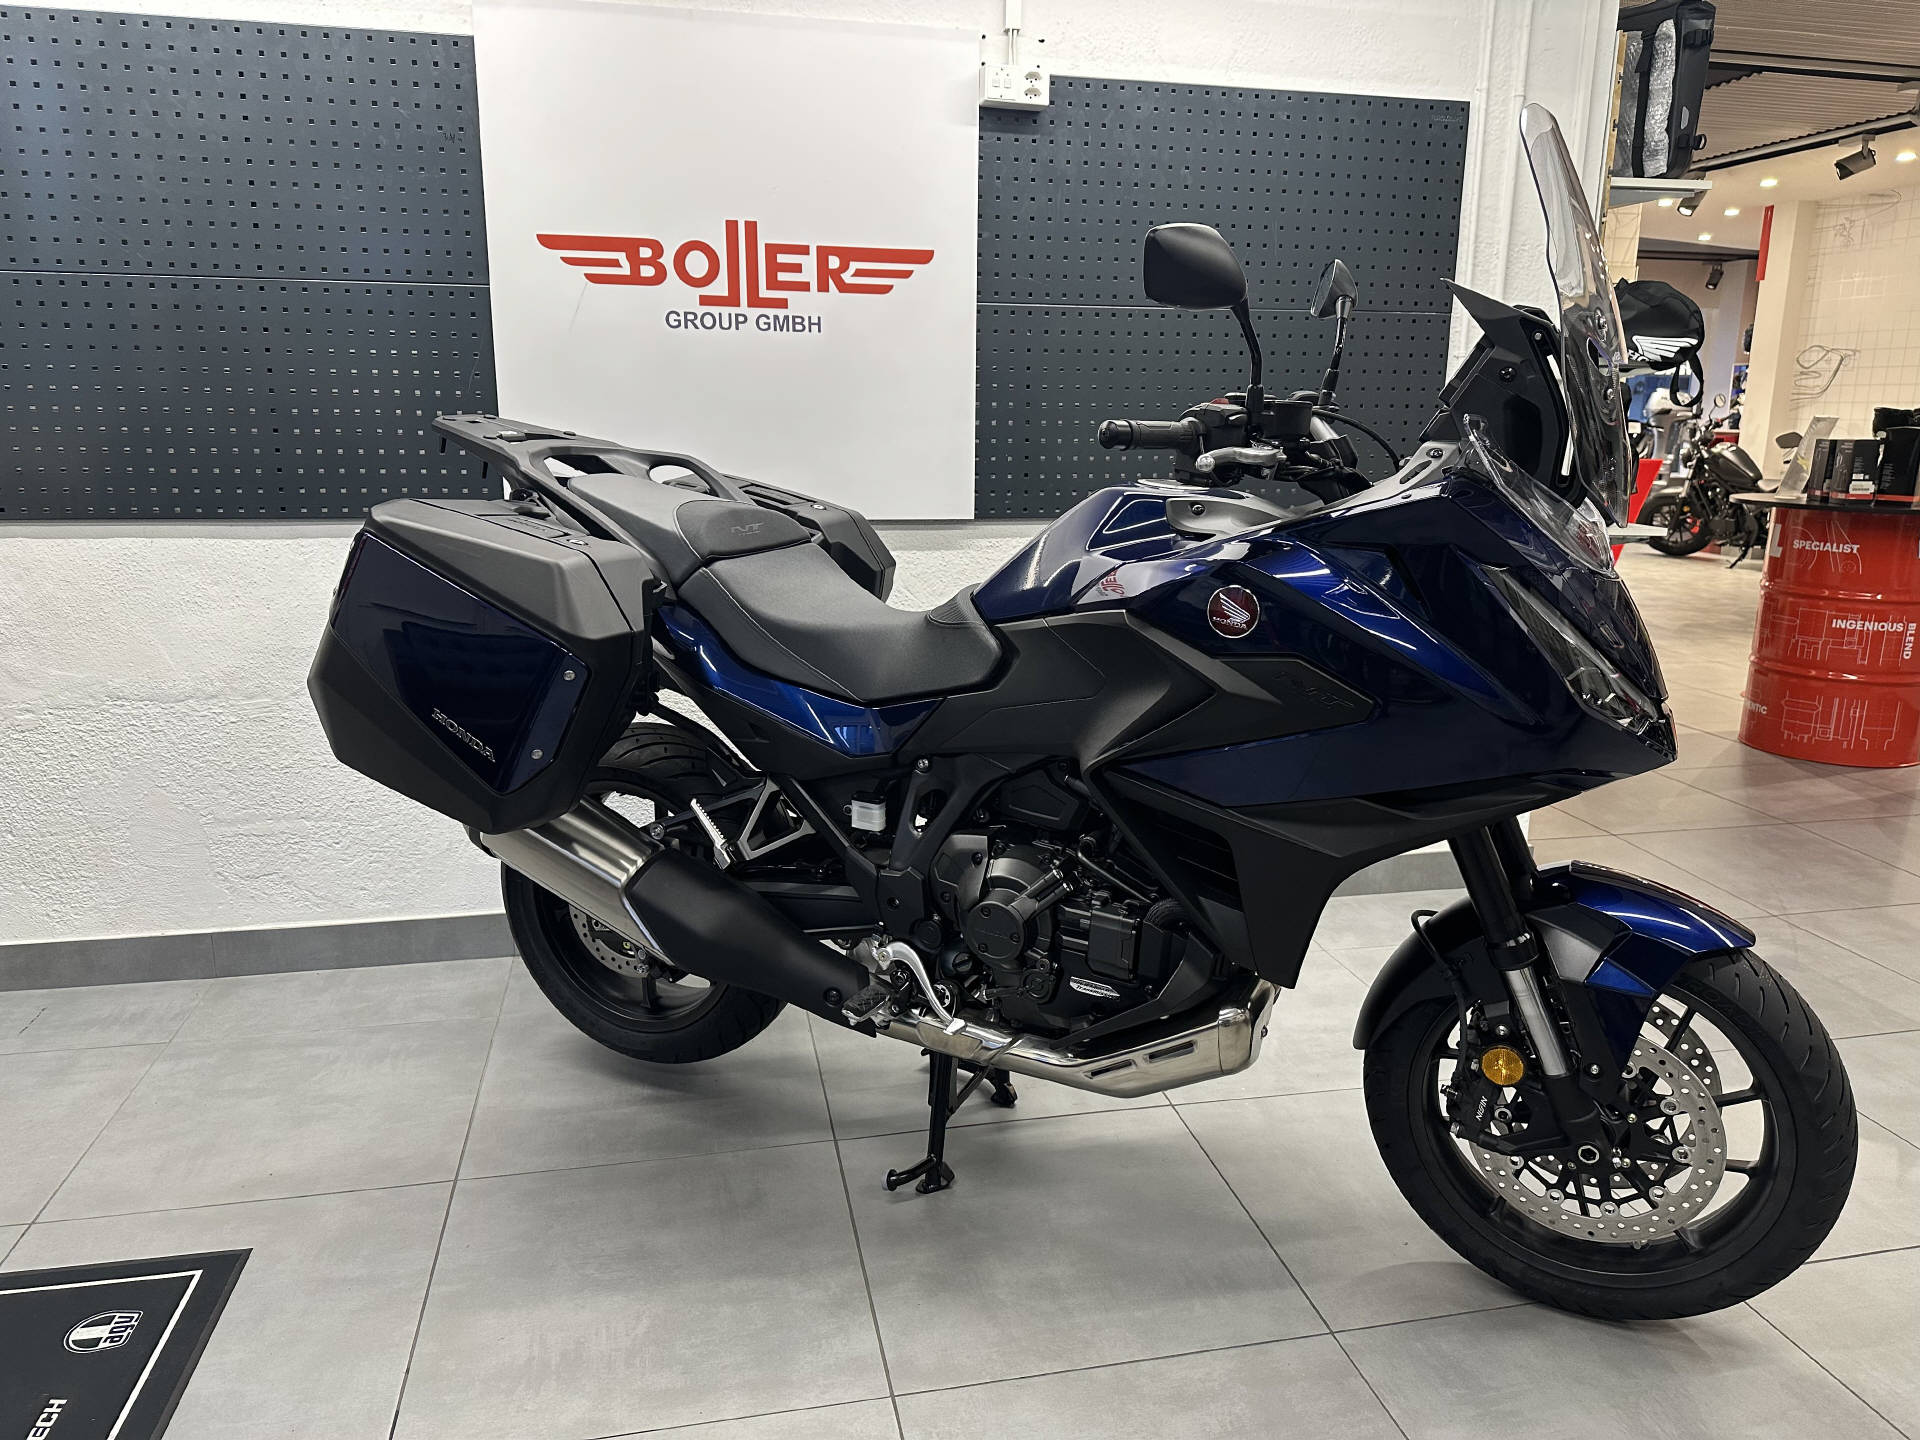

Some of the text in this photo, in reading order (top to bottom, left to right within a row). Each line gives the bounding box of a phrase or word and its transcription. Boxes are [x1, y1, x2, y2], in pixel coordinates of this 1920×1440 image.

[536, 219, 935, 309] BOLLER
[665, 310, 822, 333] GROUP GMBH
[1792, 539, 1860, 554] SPECIALIST
[1832, 618, 1904, 632] INGENIOUS
[1903, 623, 1917, 660] BLEND
[431, 707, 496, 763] HONDA
